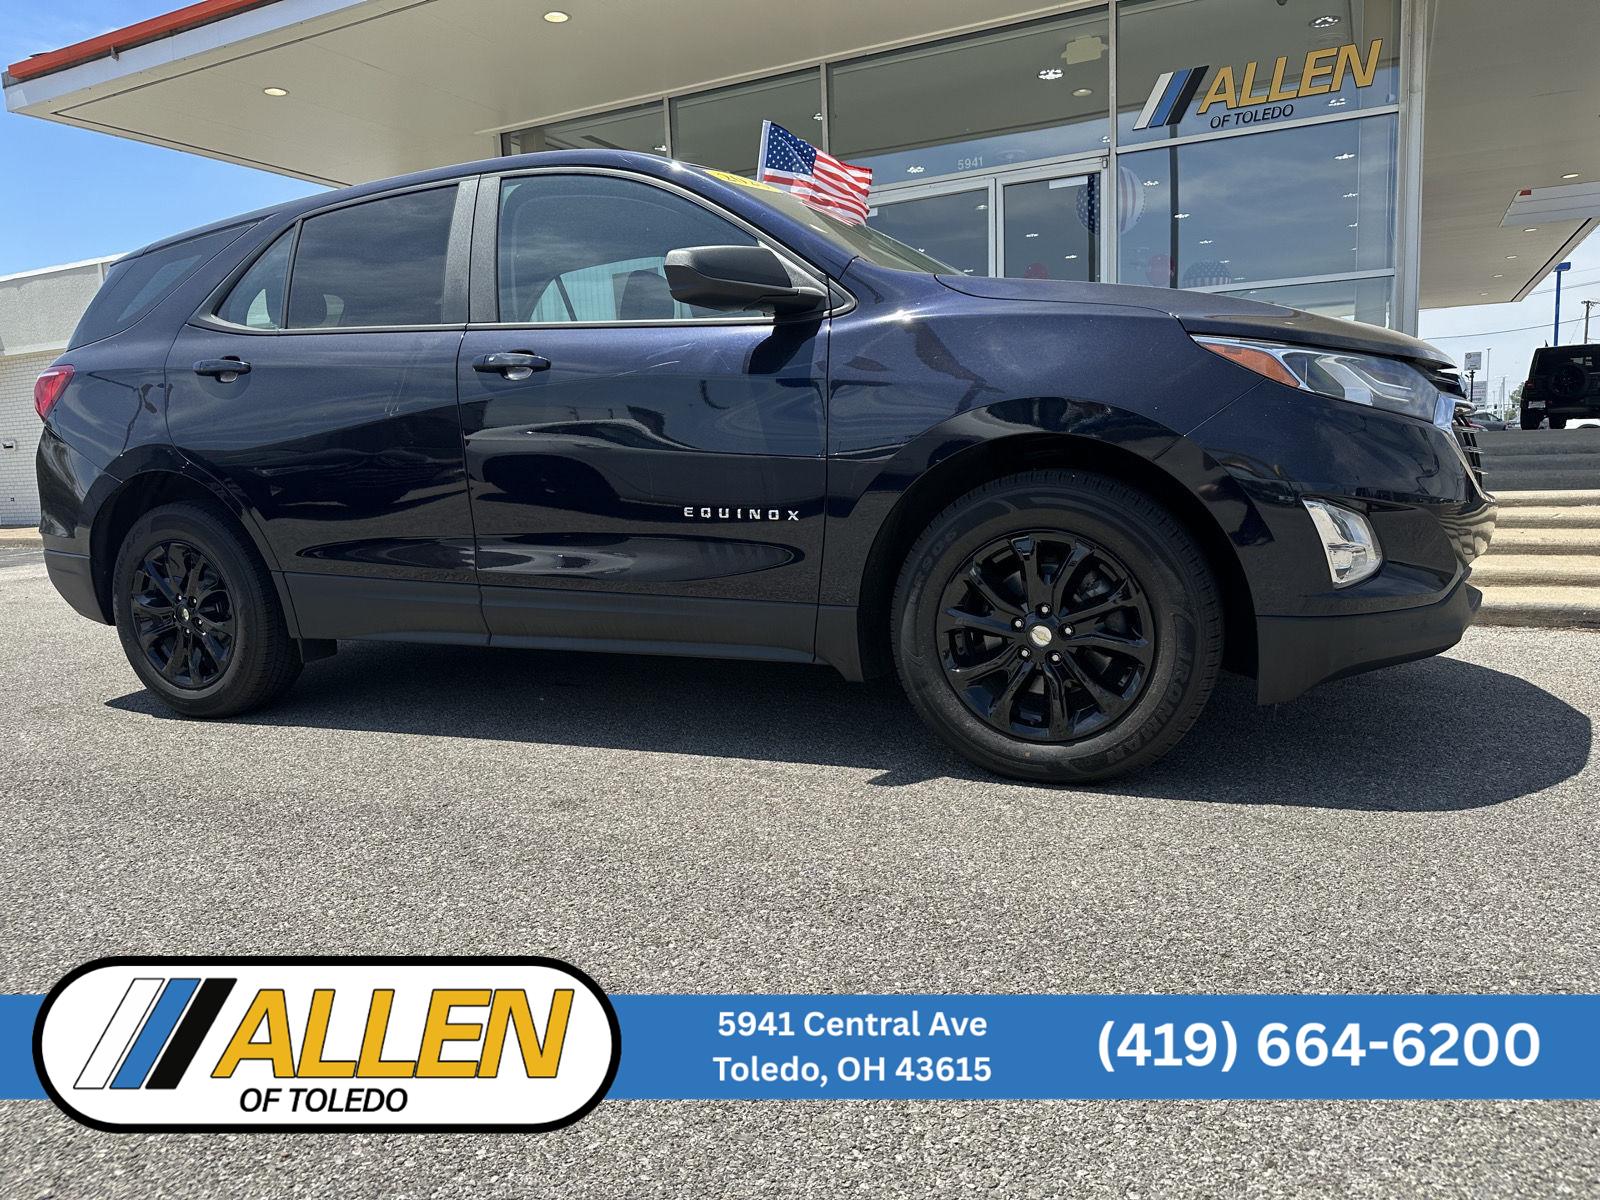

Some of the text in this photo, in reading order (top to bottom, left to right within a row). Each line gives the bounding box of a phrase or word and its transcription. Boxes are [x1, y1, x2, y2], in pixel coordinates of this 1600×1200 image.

[1196, 38, 1383, 115] ALLEN
[1210, 104, 1294, 129] OF TOLEDO
[957, 156, 983, 170] 5941
[683, 506, 799, 521] EQUINOX
